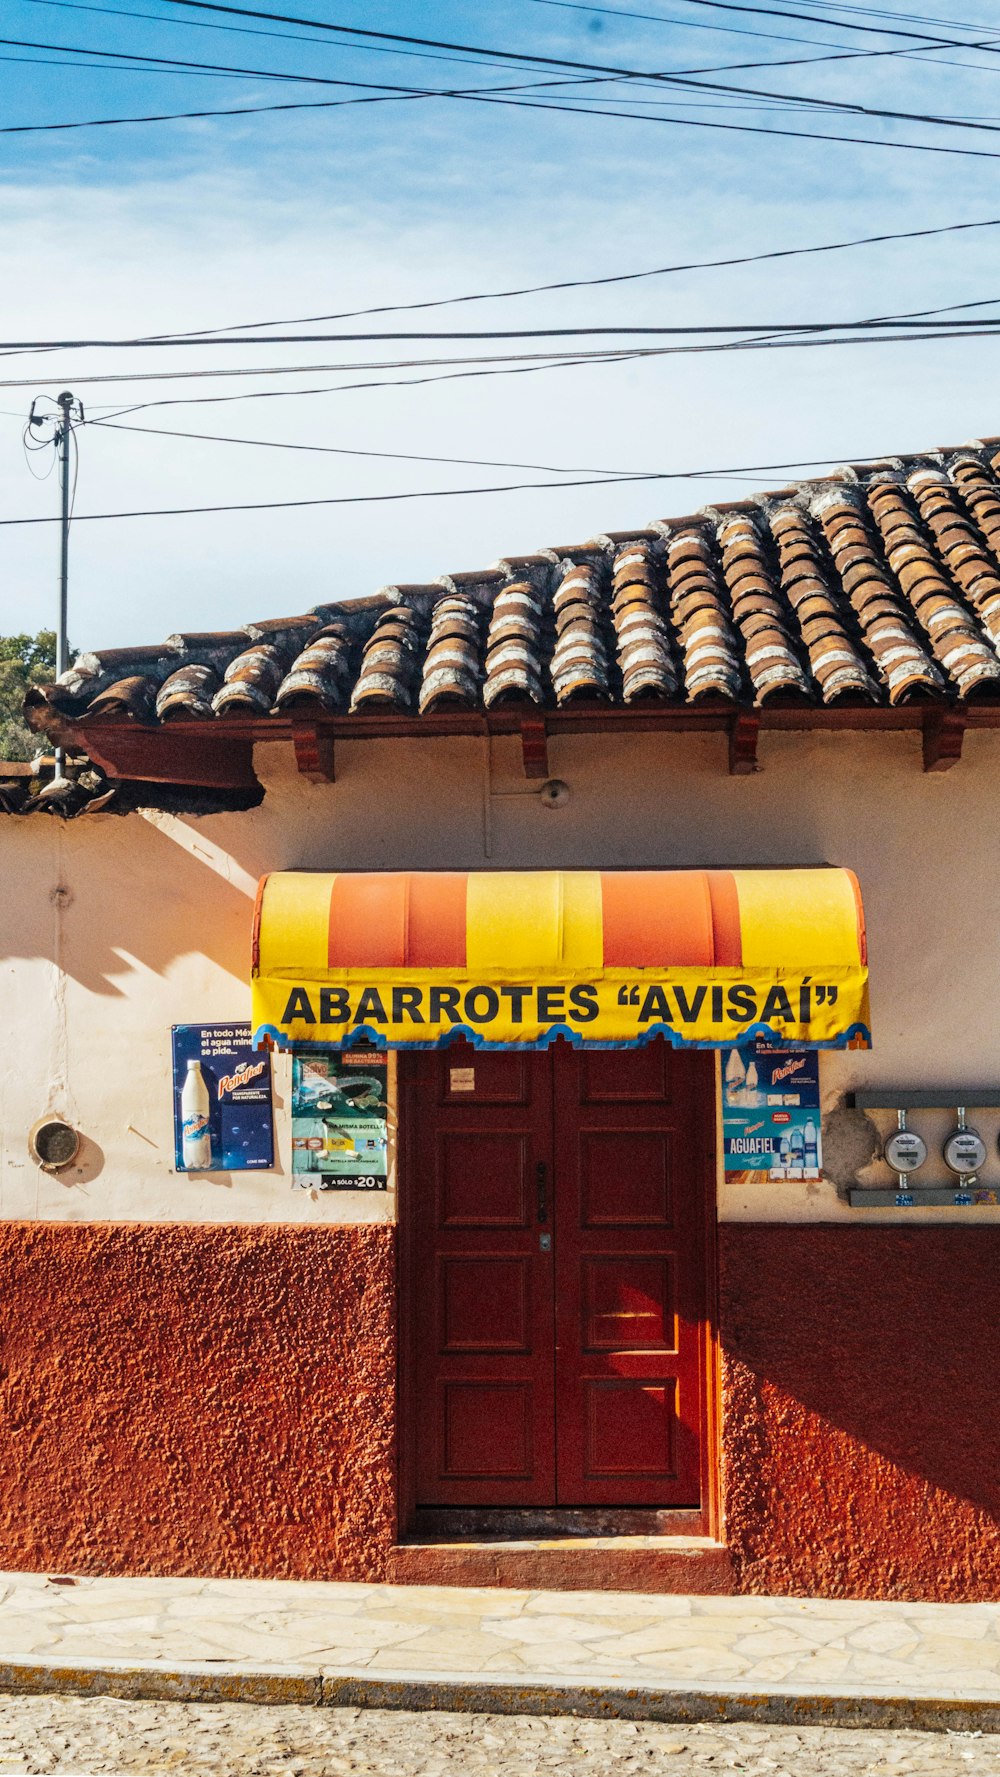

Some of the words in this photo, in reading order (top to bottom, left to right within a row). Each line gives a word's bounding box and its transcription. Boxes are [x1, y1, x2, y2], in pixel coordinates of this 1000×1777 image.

[281, 985, 599, 1024] ABARROTES
[201, 1030, 212, 1038] En
[201, 1038, 209, 1047] el
[210, 1040, 232, 1048] agua
[730, 1138, 775, 1154] AGUAFIEL
[354, 1176, 376, 1188] $20
